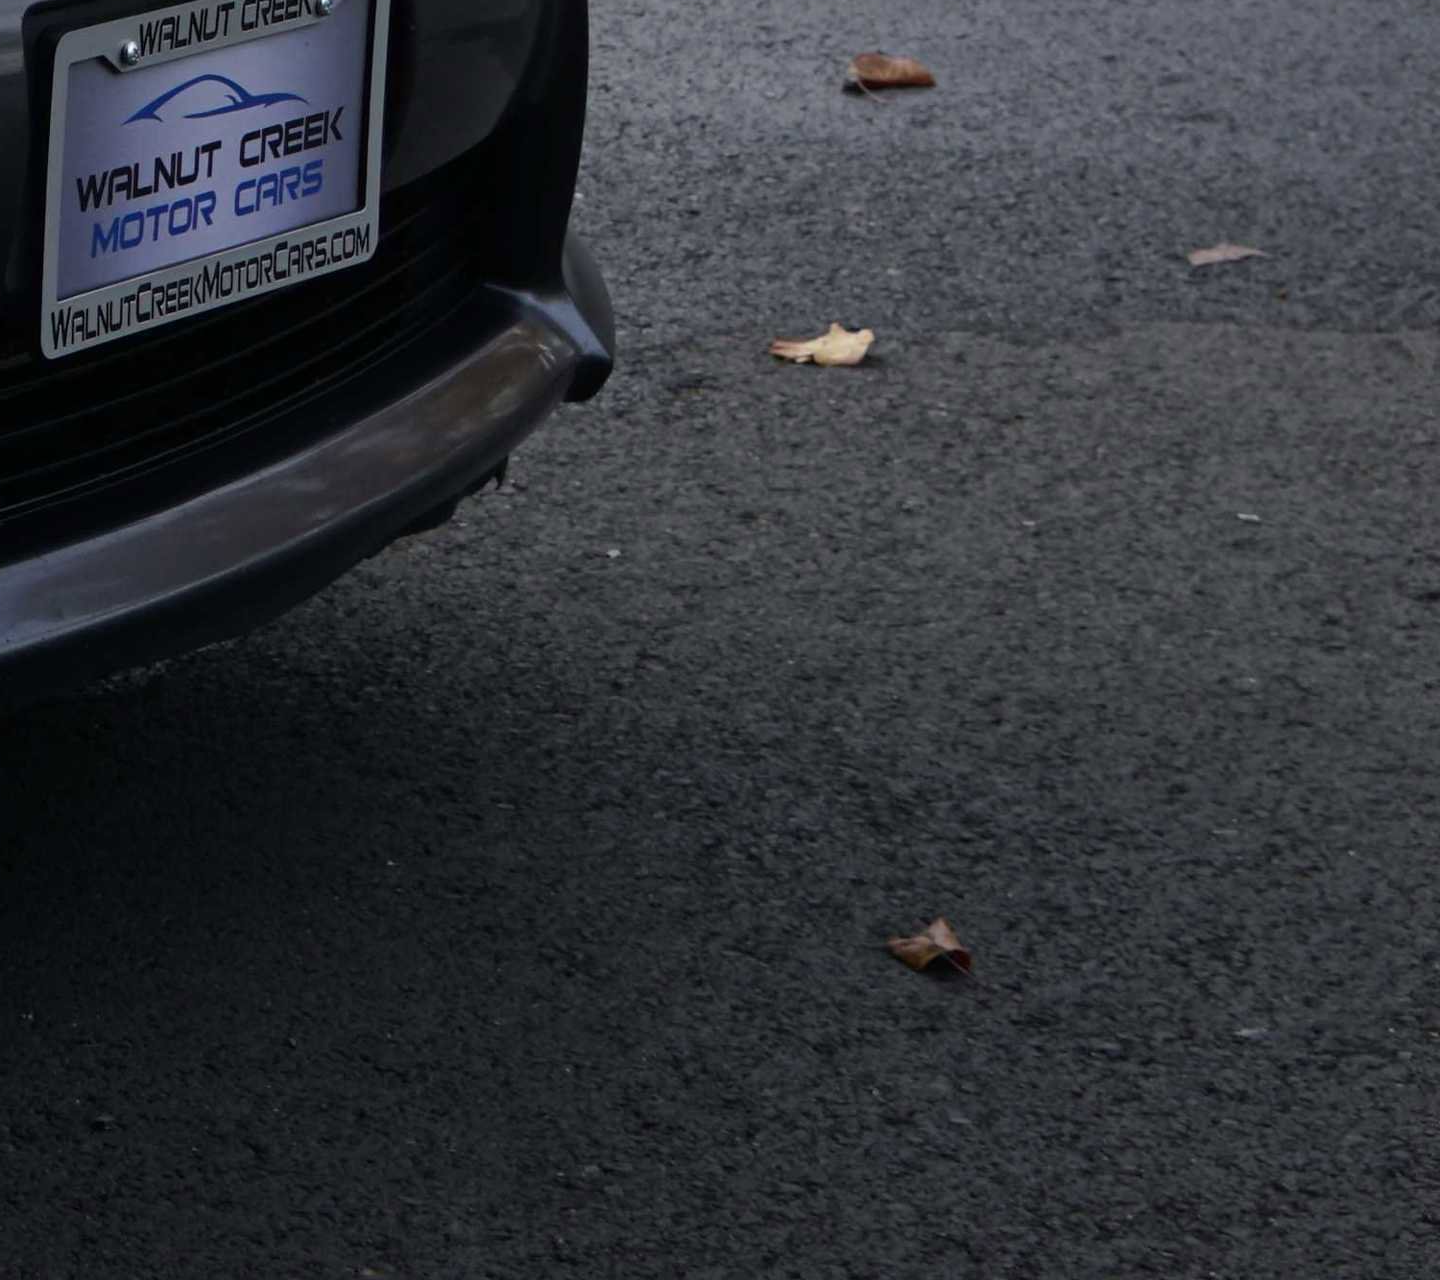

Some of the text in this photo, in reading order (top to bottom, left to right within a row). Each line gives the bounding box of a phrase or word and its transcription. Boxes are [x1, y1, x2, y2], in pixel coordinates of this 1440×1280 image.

[138, 2, 235, 57] WALNUT
[76, 106, 345, 213] WALNUT CREEK
[91, 159, 324, 258] MOTOR CARS
